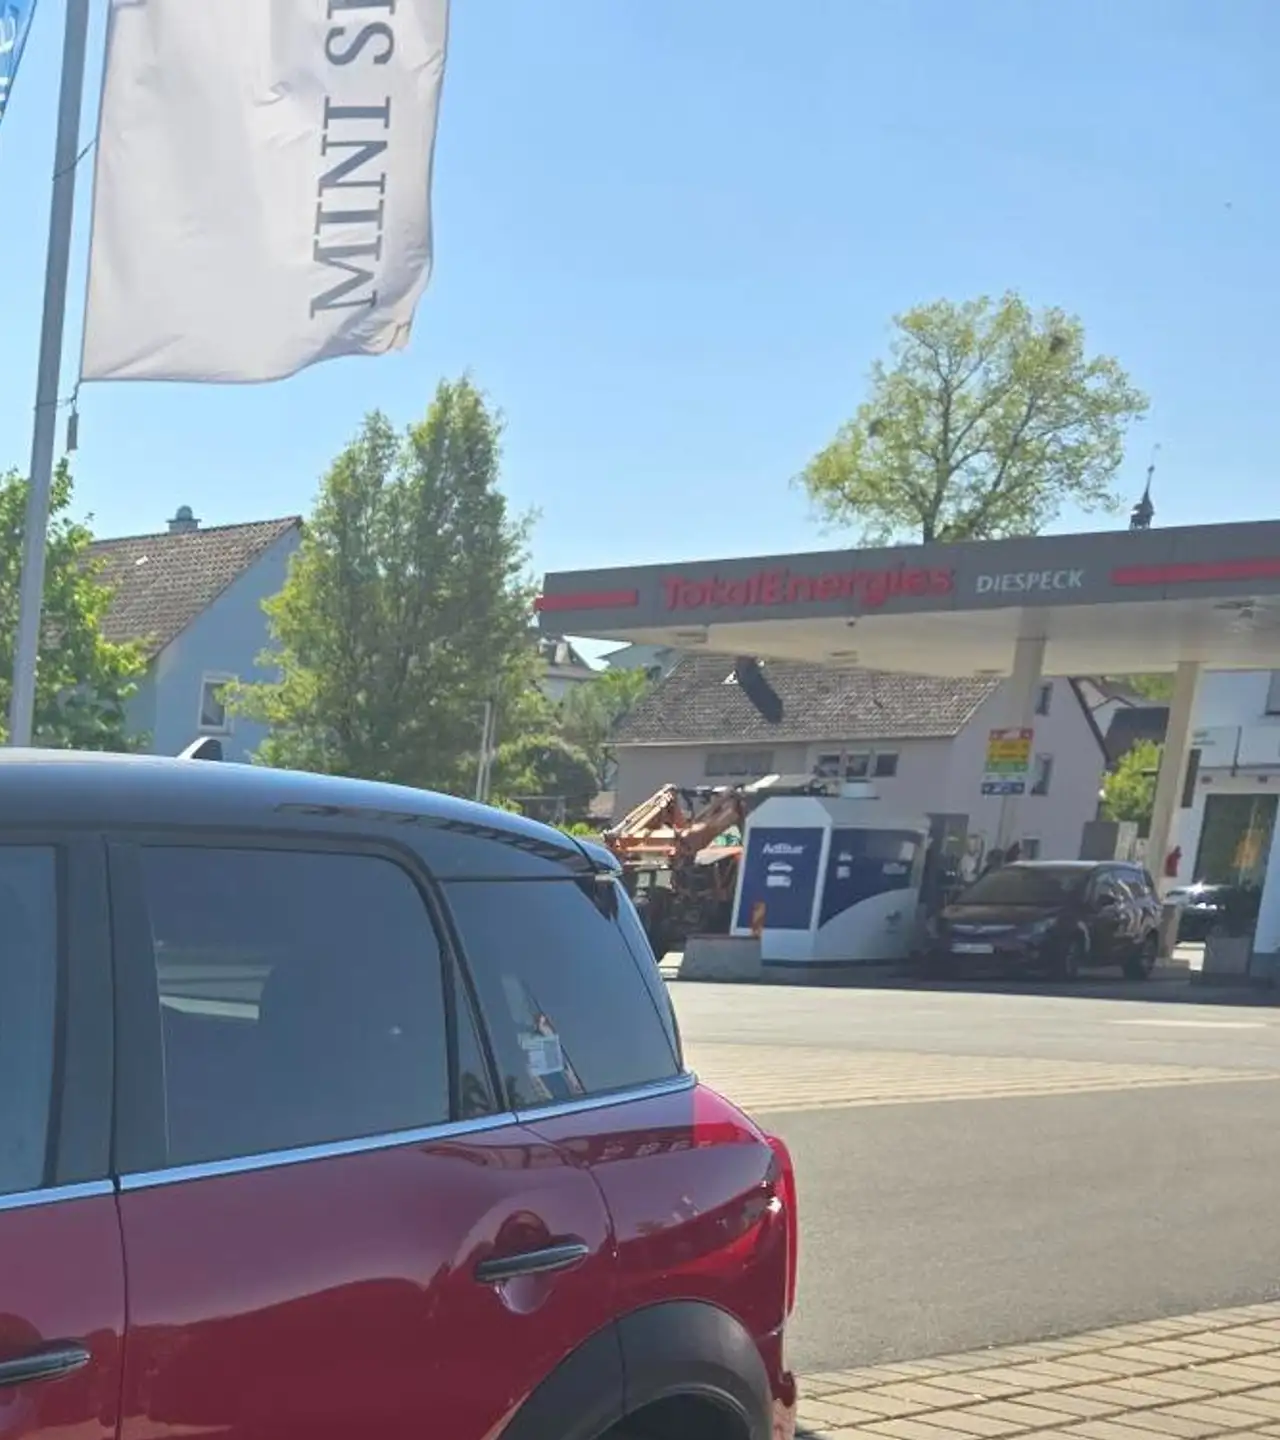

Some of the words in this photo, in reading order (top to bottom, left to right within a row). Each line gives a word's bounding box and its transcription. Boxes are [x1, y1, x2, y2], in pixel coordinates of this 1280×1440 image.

[310, 96, 392, 320] MINI
[661, 563, 957, 609] TotalEnergies
[975, 569, 1085, 594] DIESPECK
